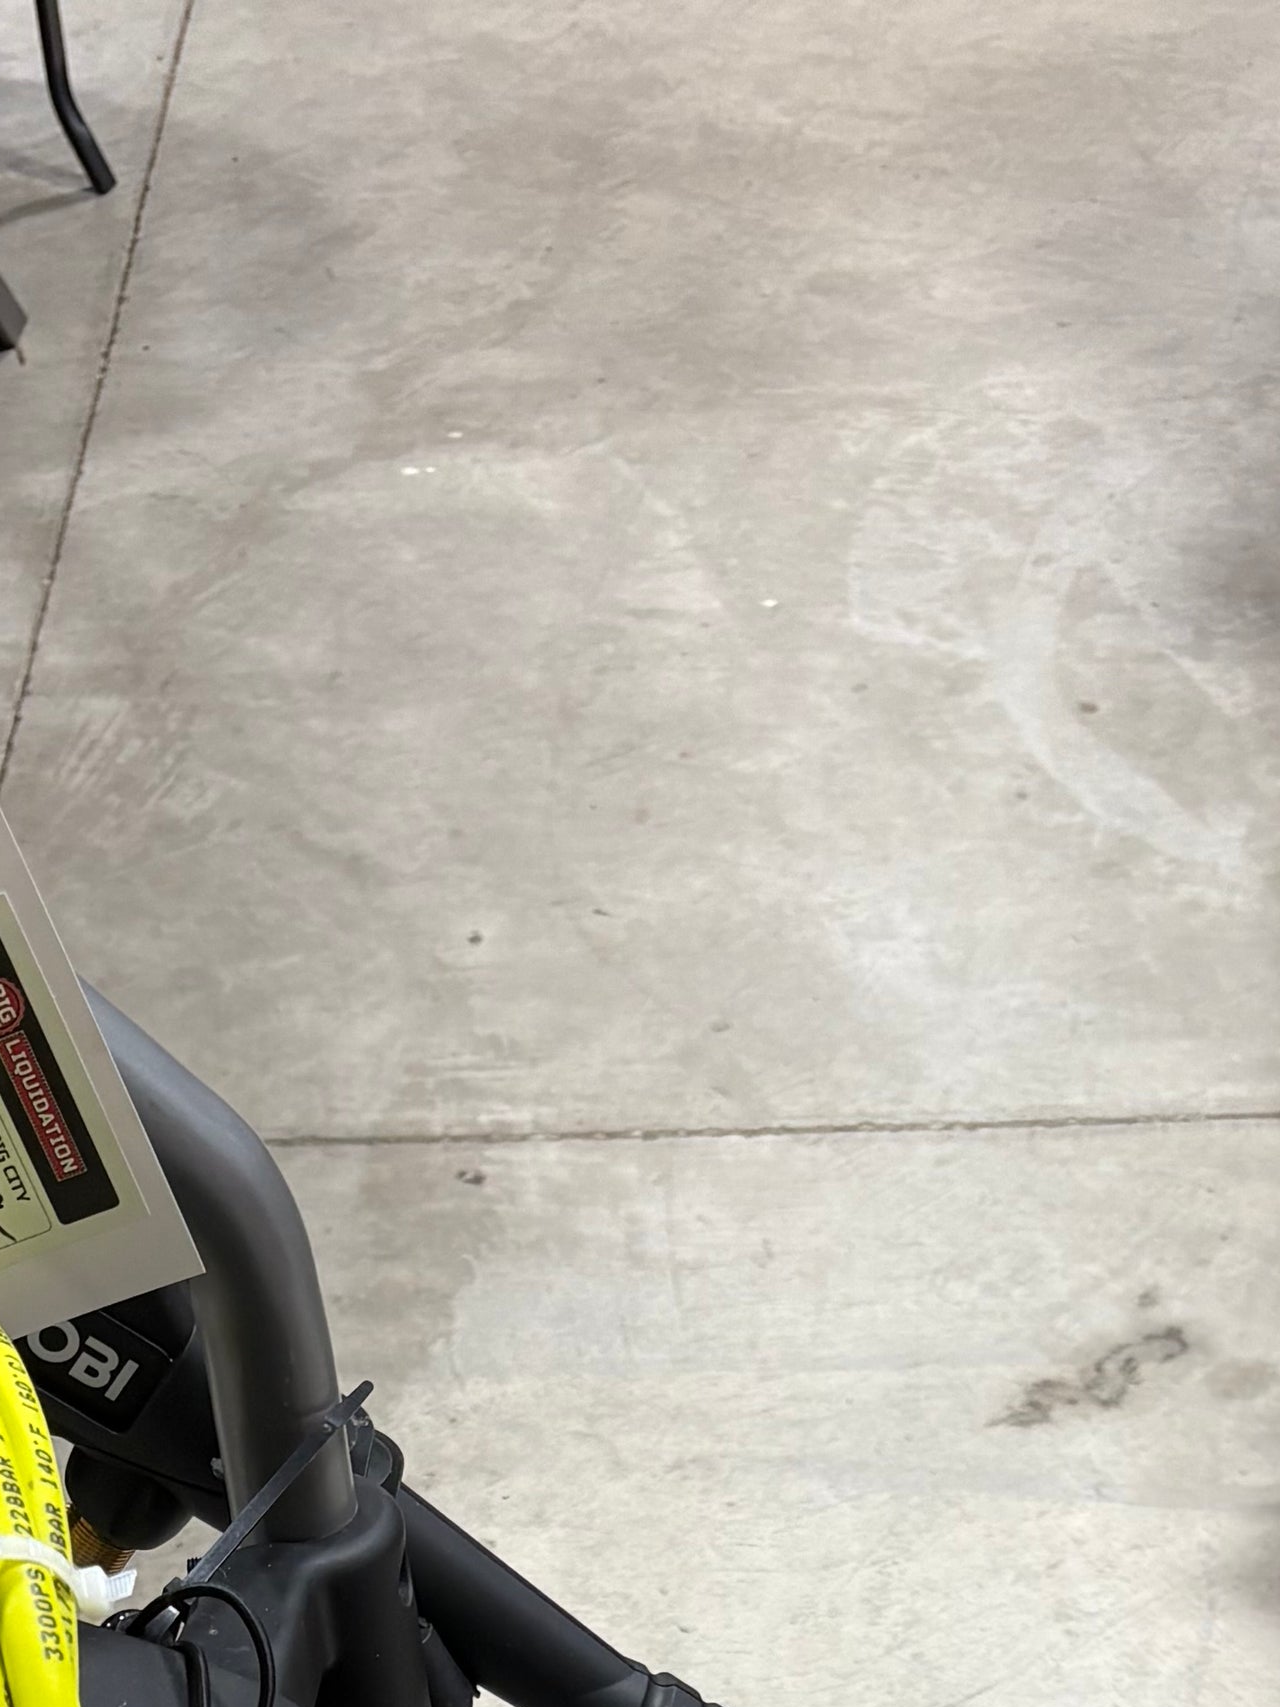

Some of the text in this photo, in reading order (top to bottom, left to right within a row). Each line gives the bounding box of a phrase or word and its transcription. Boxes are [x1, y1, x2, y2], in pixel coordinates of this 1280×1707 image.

[5, 1038, 79, 1174] LIQUIDATION
[2, 1163, 32, 1202] CITY
[27, 1320, 140, 1402] OBI
